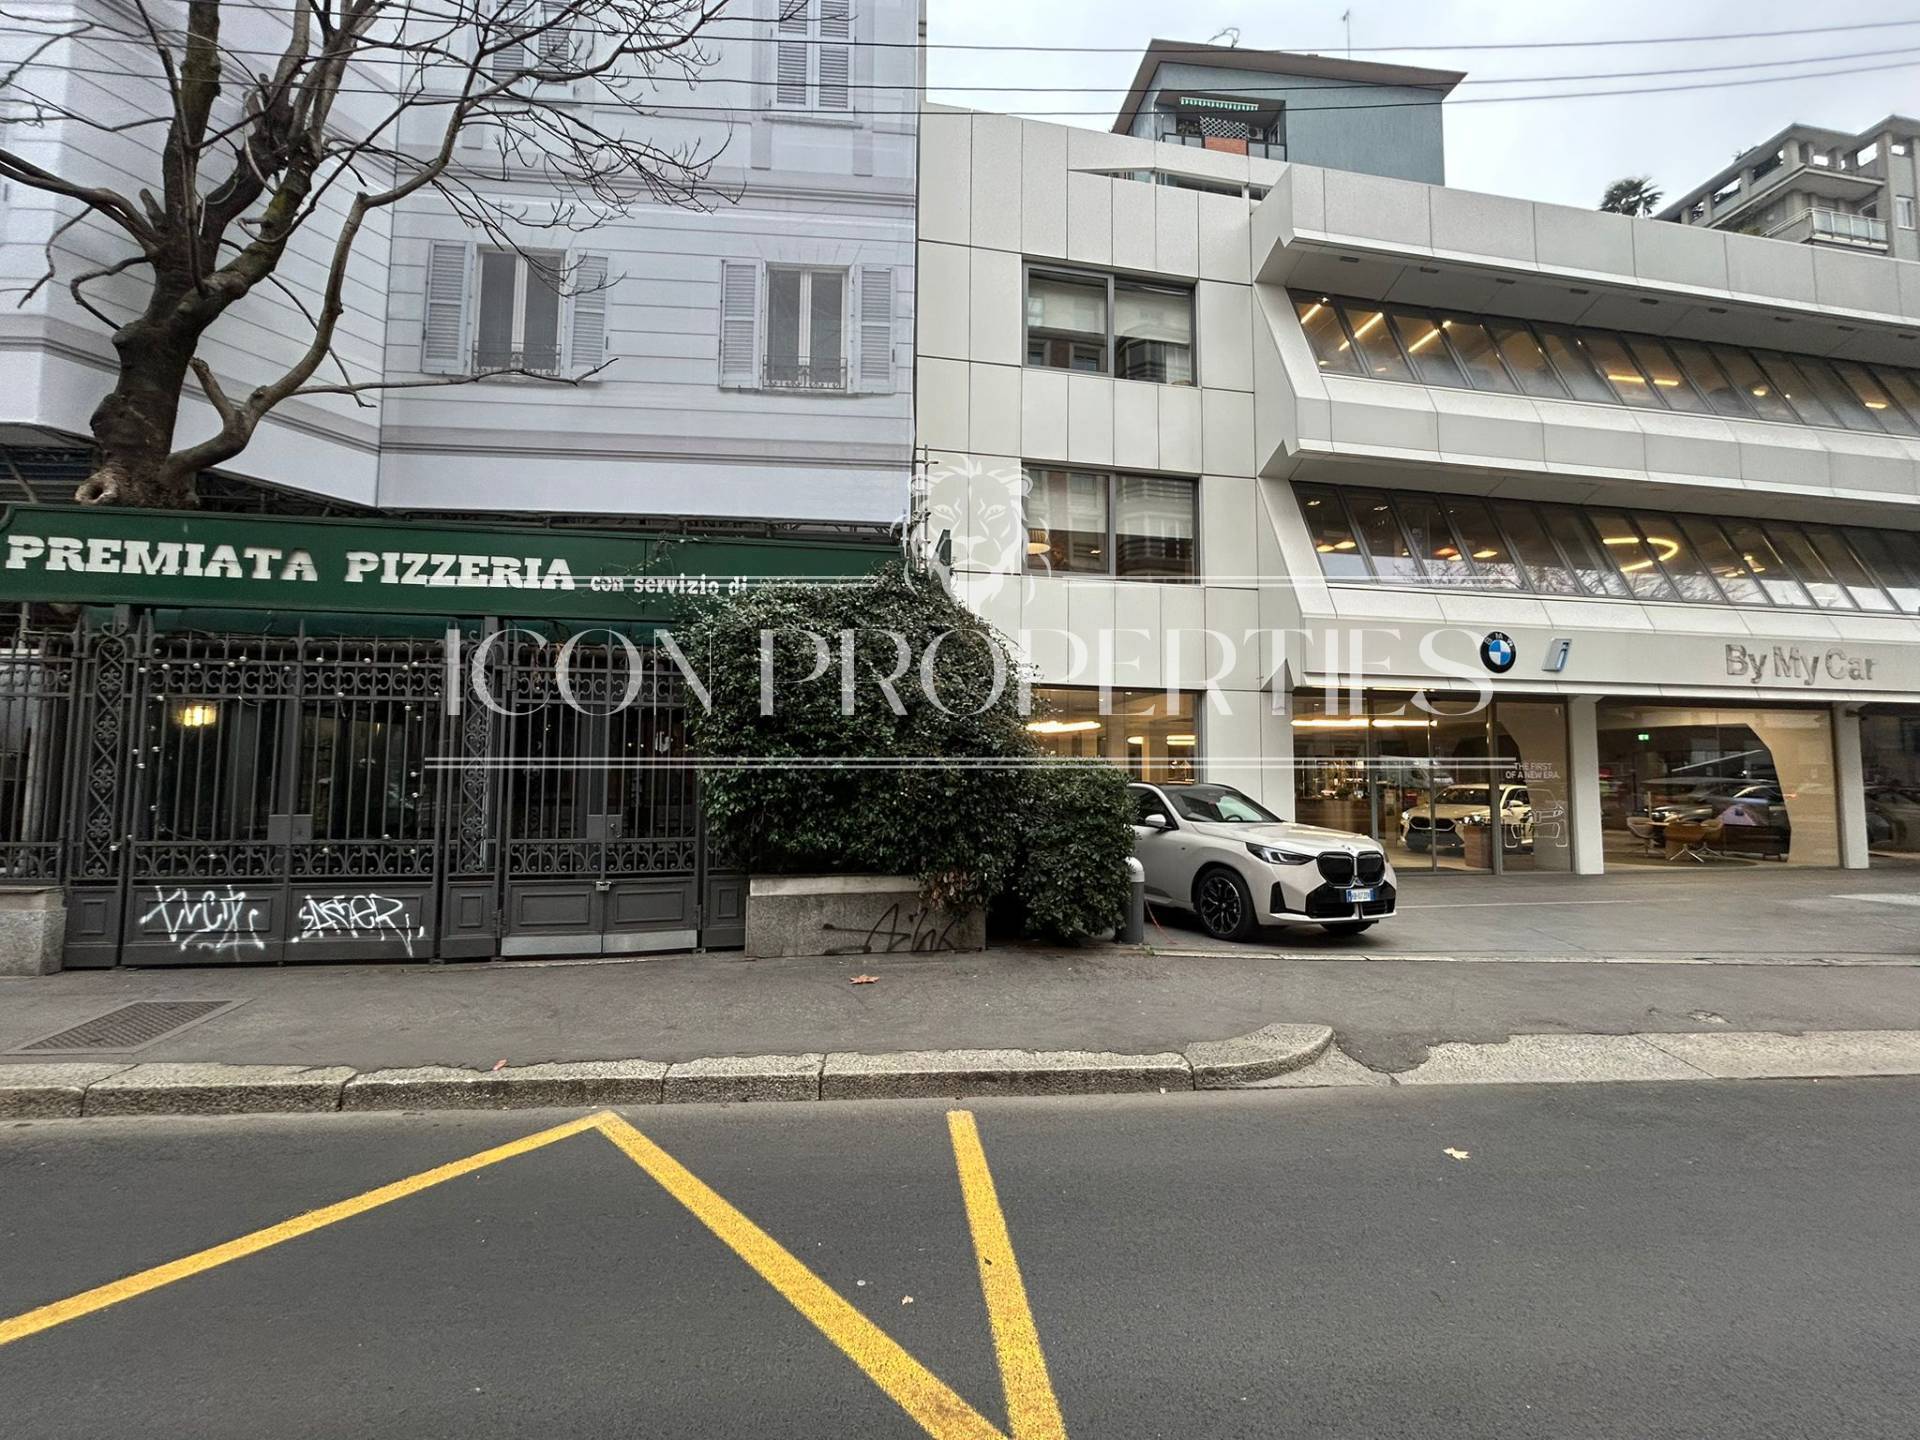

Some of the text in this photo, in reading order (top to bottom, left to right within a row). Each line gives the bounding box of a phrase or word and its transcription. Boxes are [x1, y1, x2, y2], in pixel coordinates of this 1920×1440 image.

[5, 535, 576, 590] PREMIATA PIZZERIA
[590, 572, 748, 597] con servizio di
[1505, 770, 1517, 779] OF
[1514, 762, 1530, 771] THE
